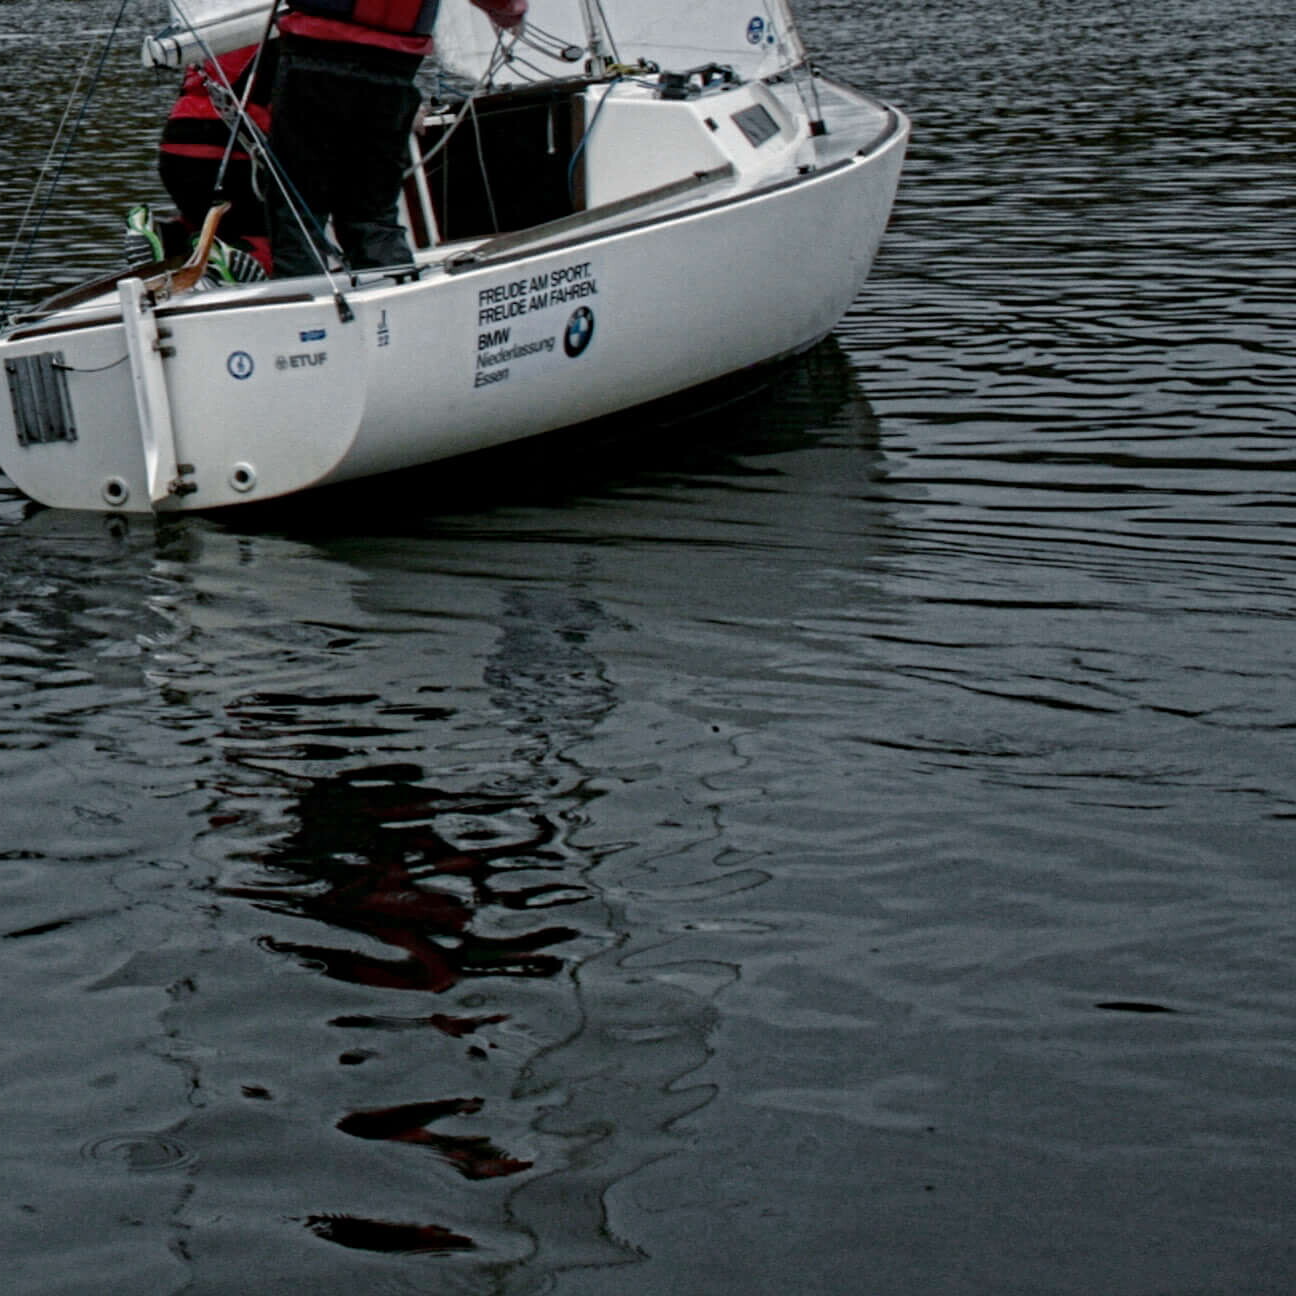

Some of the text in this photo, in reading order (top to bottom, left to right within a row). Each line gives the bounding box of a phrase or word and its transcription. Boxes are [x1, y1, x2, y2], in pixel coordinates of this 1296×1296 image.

[478, 279, 528, 308] FREUDE
[528, 273, 549, 294] AM
[478, 298, 528, 327] FREUDE
[528, 291, 549, 313] AM
[476, 336, 556, 370] Niederlassung
[478, 326, 511, 352] BMW
[289, 352, 329, 369] ETUF
[473, 367, 510, 389] Essen
